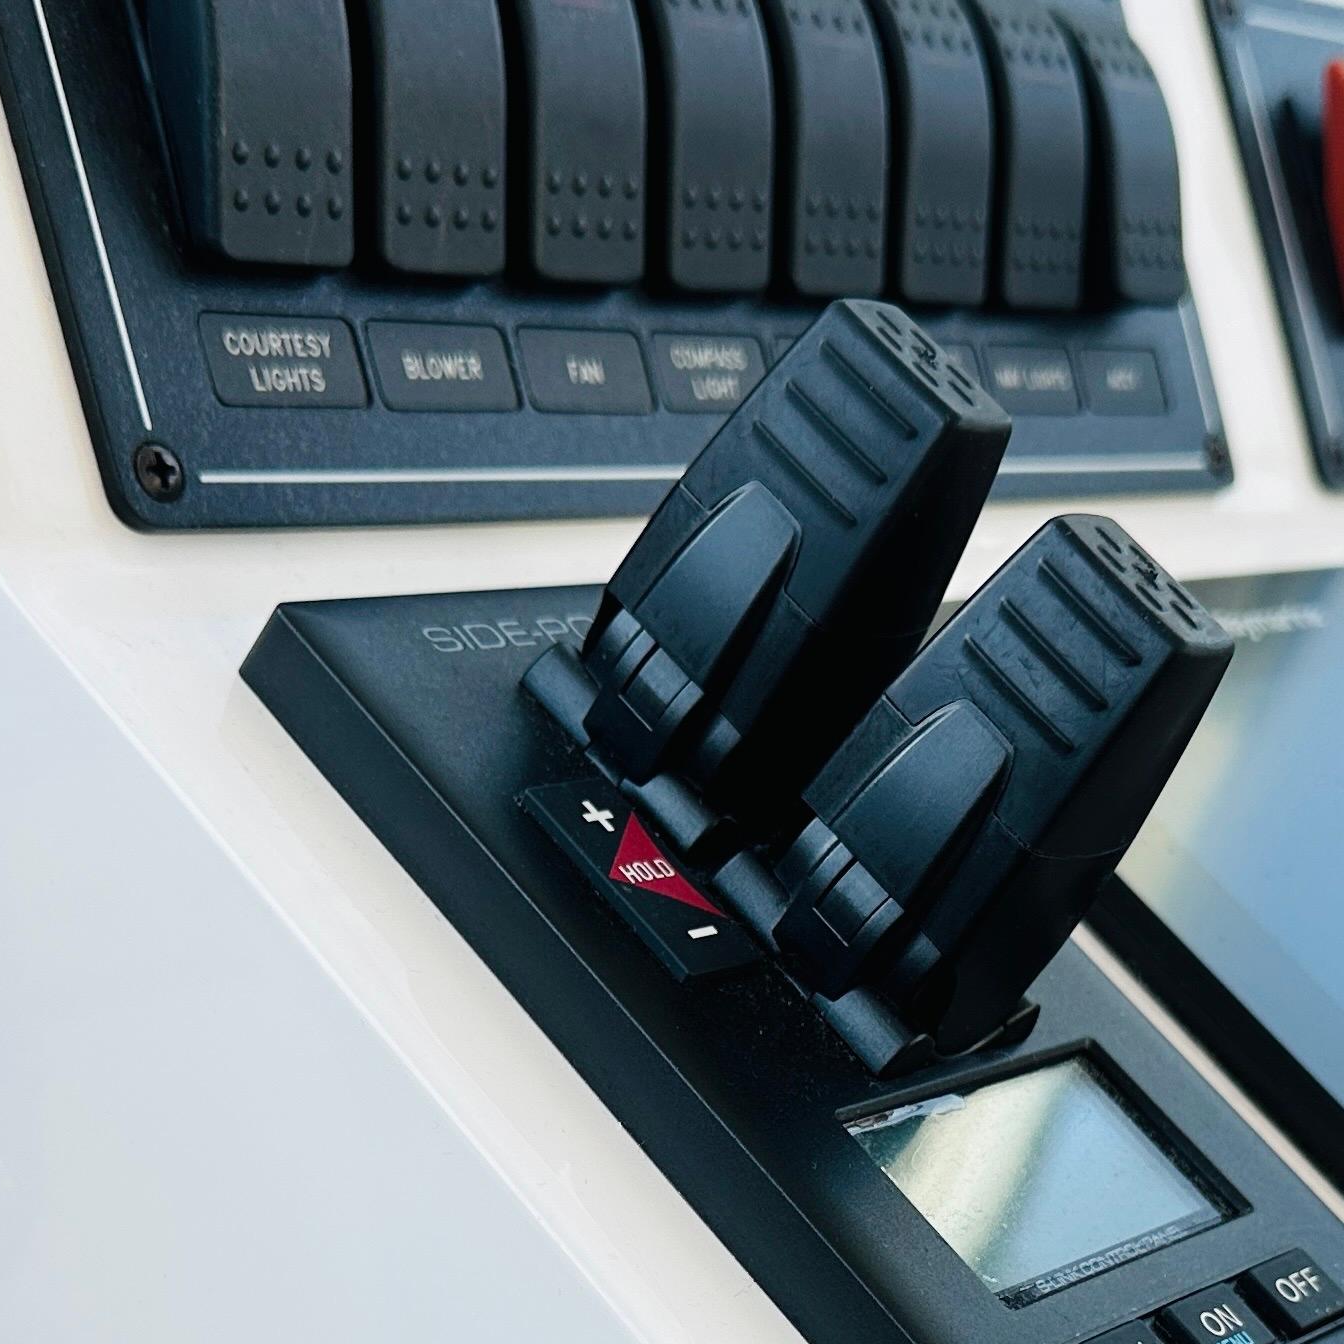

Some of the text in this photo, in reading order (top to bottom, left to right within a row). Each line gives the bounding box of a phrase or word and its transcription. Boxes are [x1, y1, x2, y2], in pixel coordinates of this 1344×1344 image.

[222, 327, 331, 357] COURTESY
[248, 363, 326, 393] LIGHTS
[401, 349, 483, 381] BLOWER
[566, 354, 605, 384] FAN
[422, 616, 594, 652] SIDE-PO
[618, 859, 675, 885] HOLD
[1275, 1266, 1320, 1303] OFF
[1200, 1304, 1243, 1337] ON
